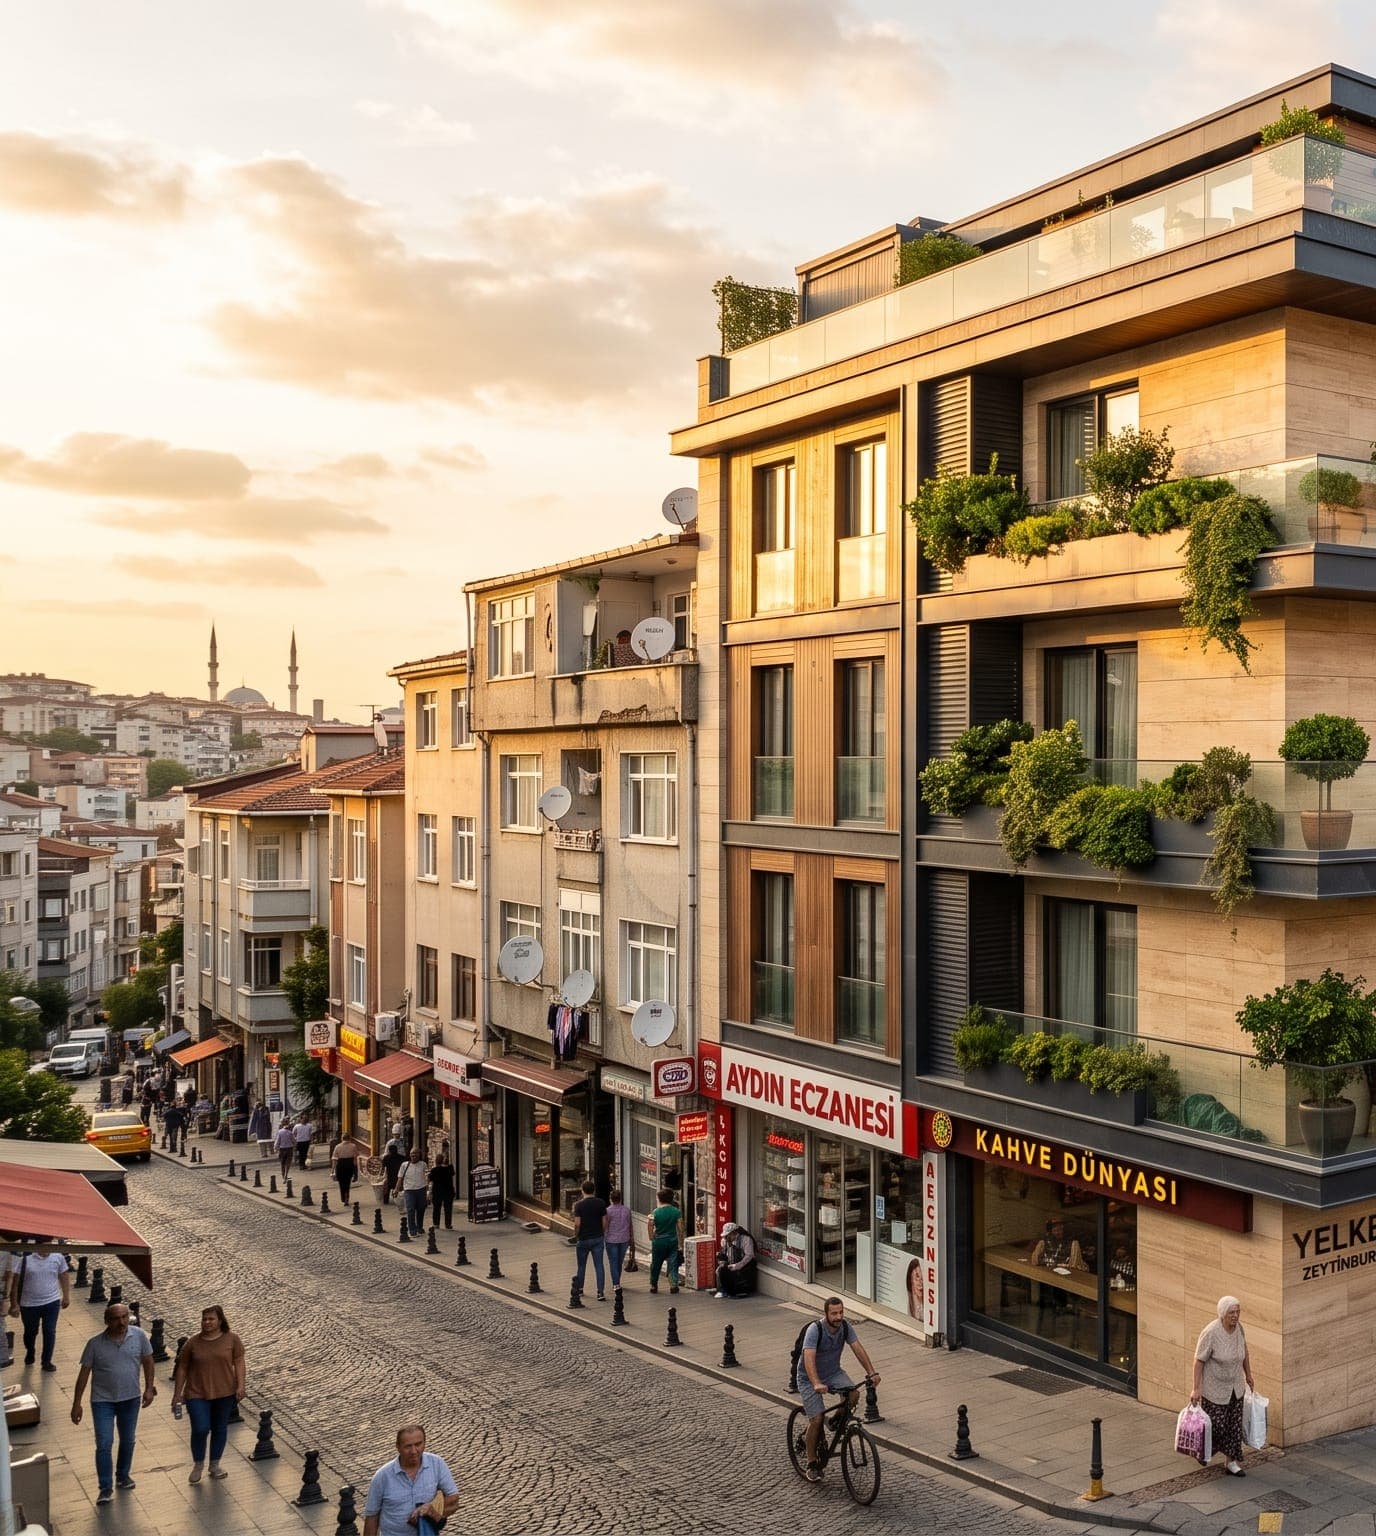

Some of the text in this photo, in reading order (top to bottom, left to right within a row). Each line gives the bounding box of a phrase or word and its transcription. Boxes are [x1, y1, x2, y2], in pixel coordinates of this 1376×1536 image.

[726, 1063, 784, 1107] AYDIN
[790, 1078, 895, 1139] ECZANESİ
[976, 1128, 1177, 1205] KAHVE DÜNYASI
